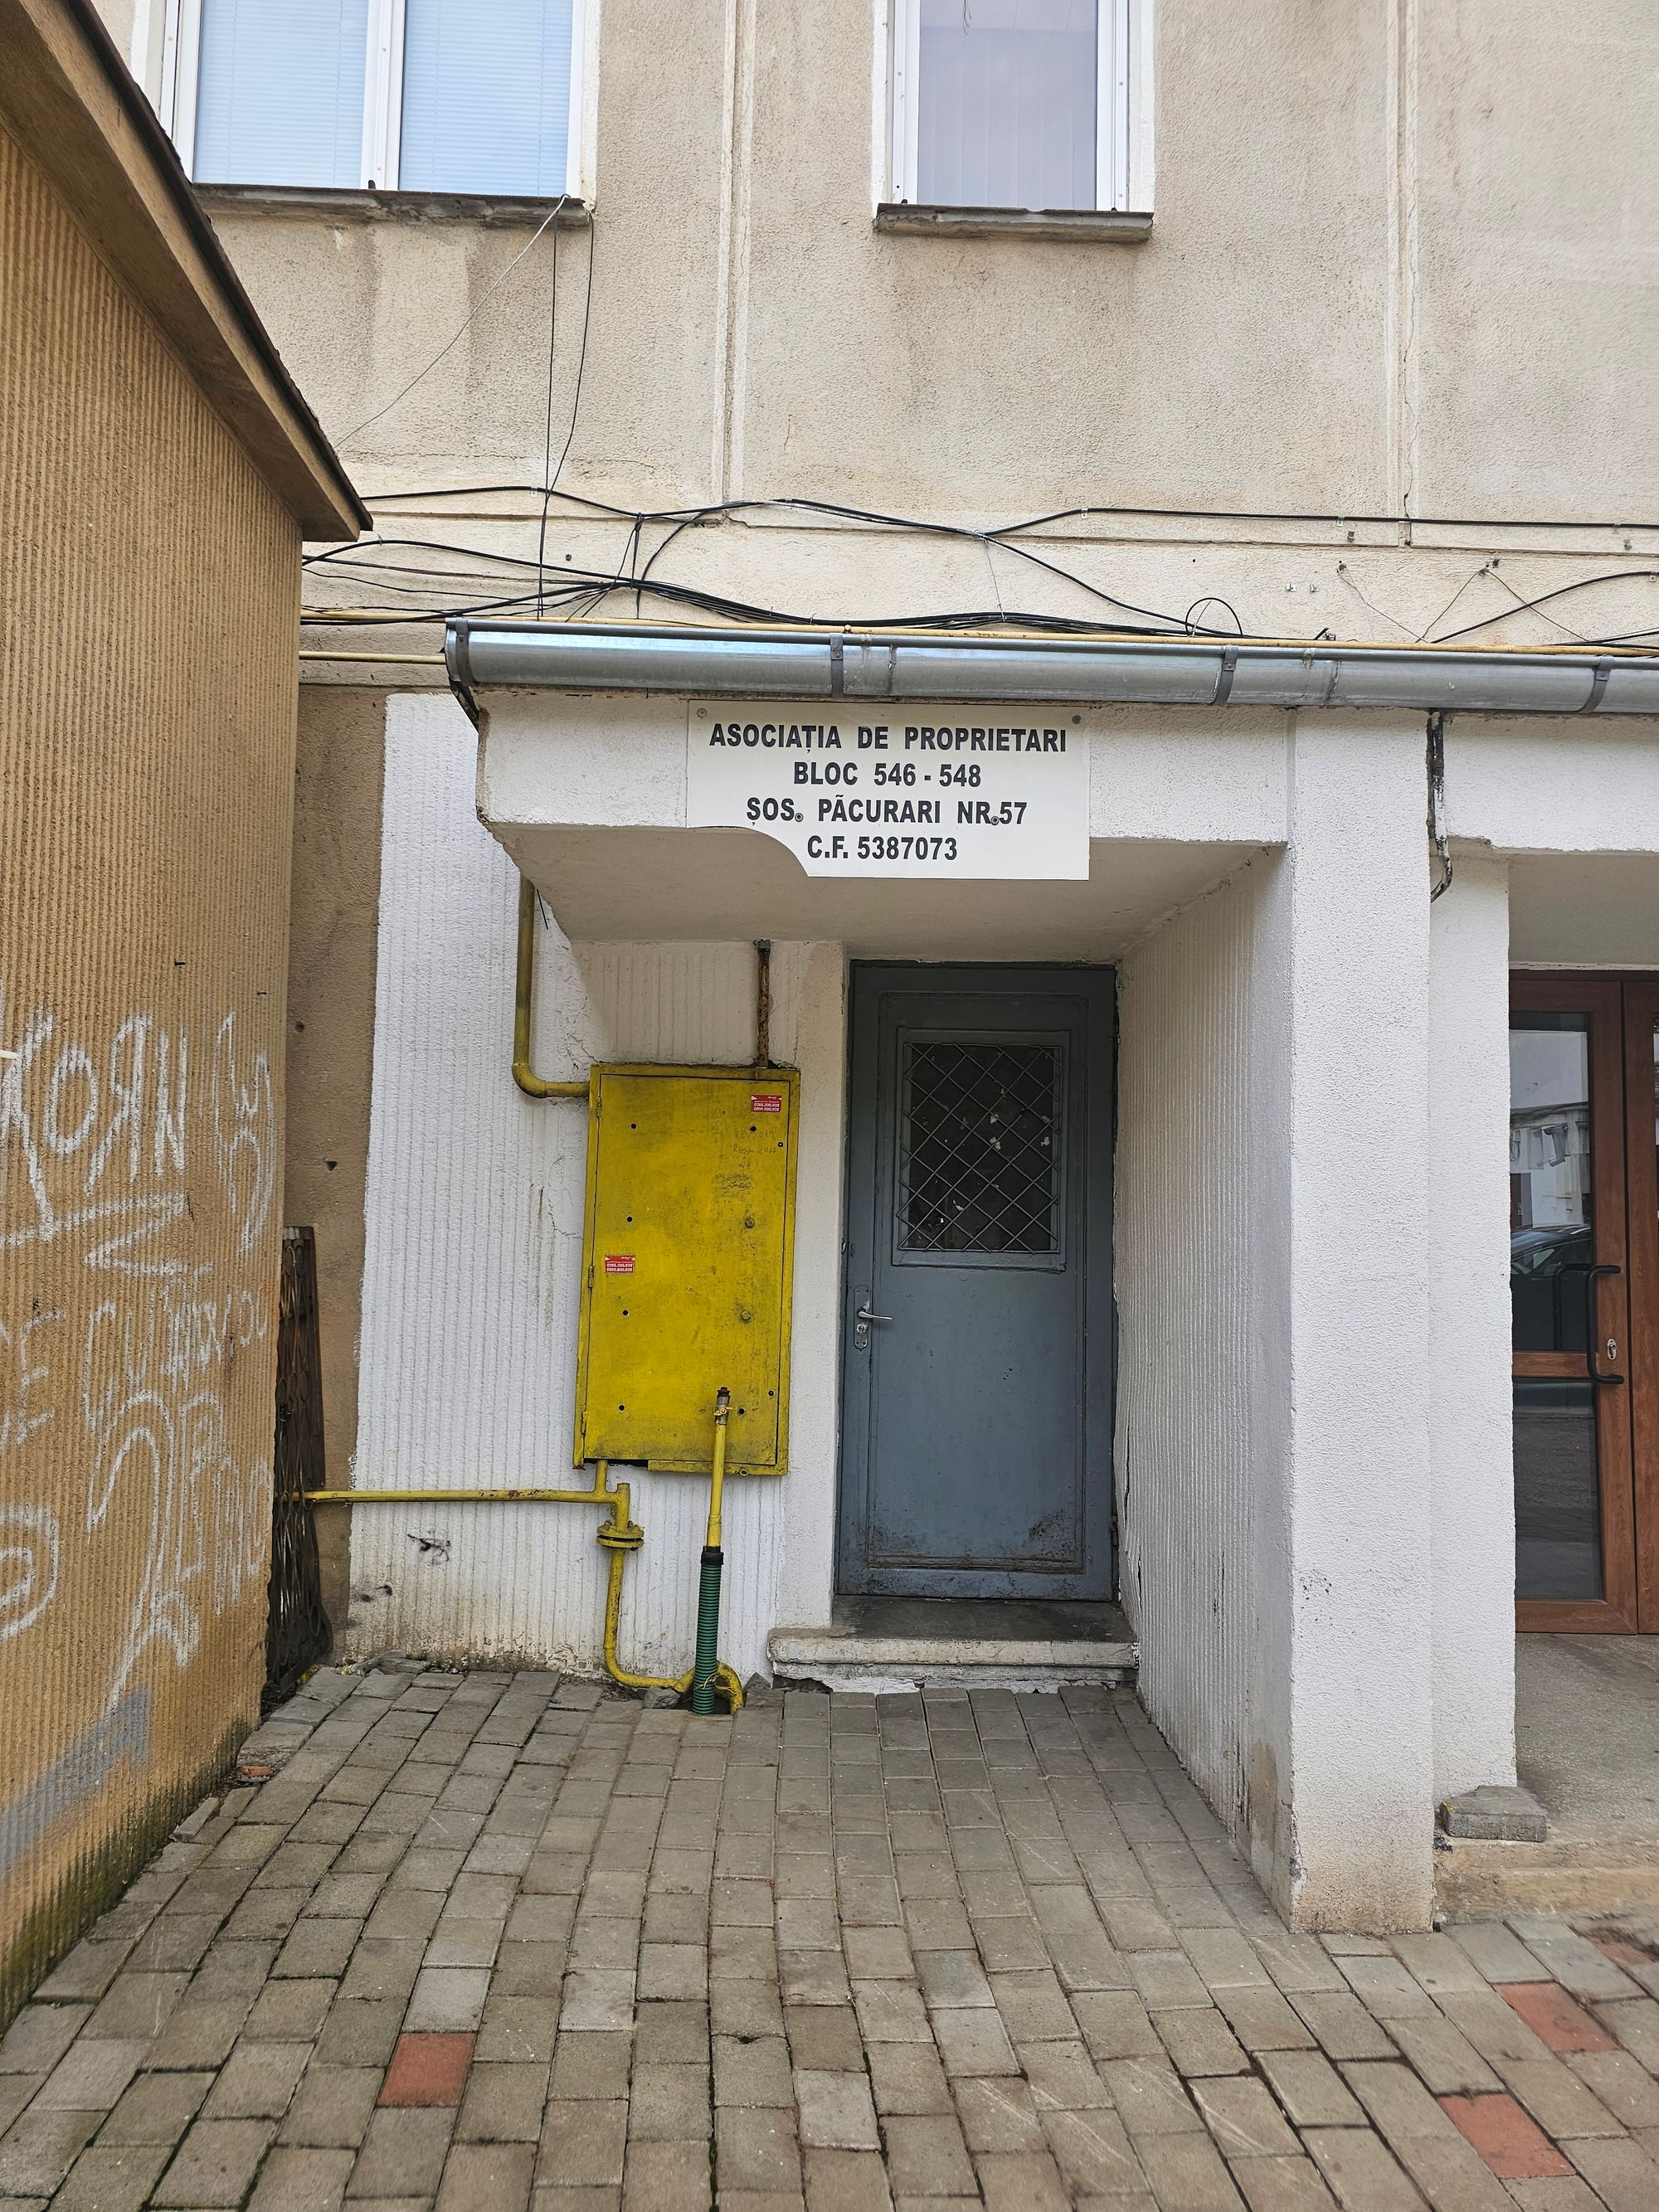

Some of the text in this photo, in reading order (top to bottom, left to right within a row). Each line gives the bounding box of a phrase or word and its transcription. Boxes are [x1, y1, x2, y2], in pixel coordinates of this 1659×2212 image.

[858, 726, 889, 750] DE
[904, 726, 1068, 752] PROPRIETARI
[794, 761, 858, 785] BLOC
[873, 762, 917, 786] 546
[939, 764, 981, 788] 548
[807, 835, 957, 861] C.F. 5387073
